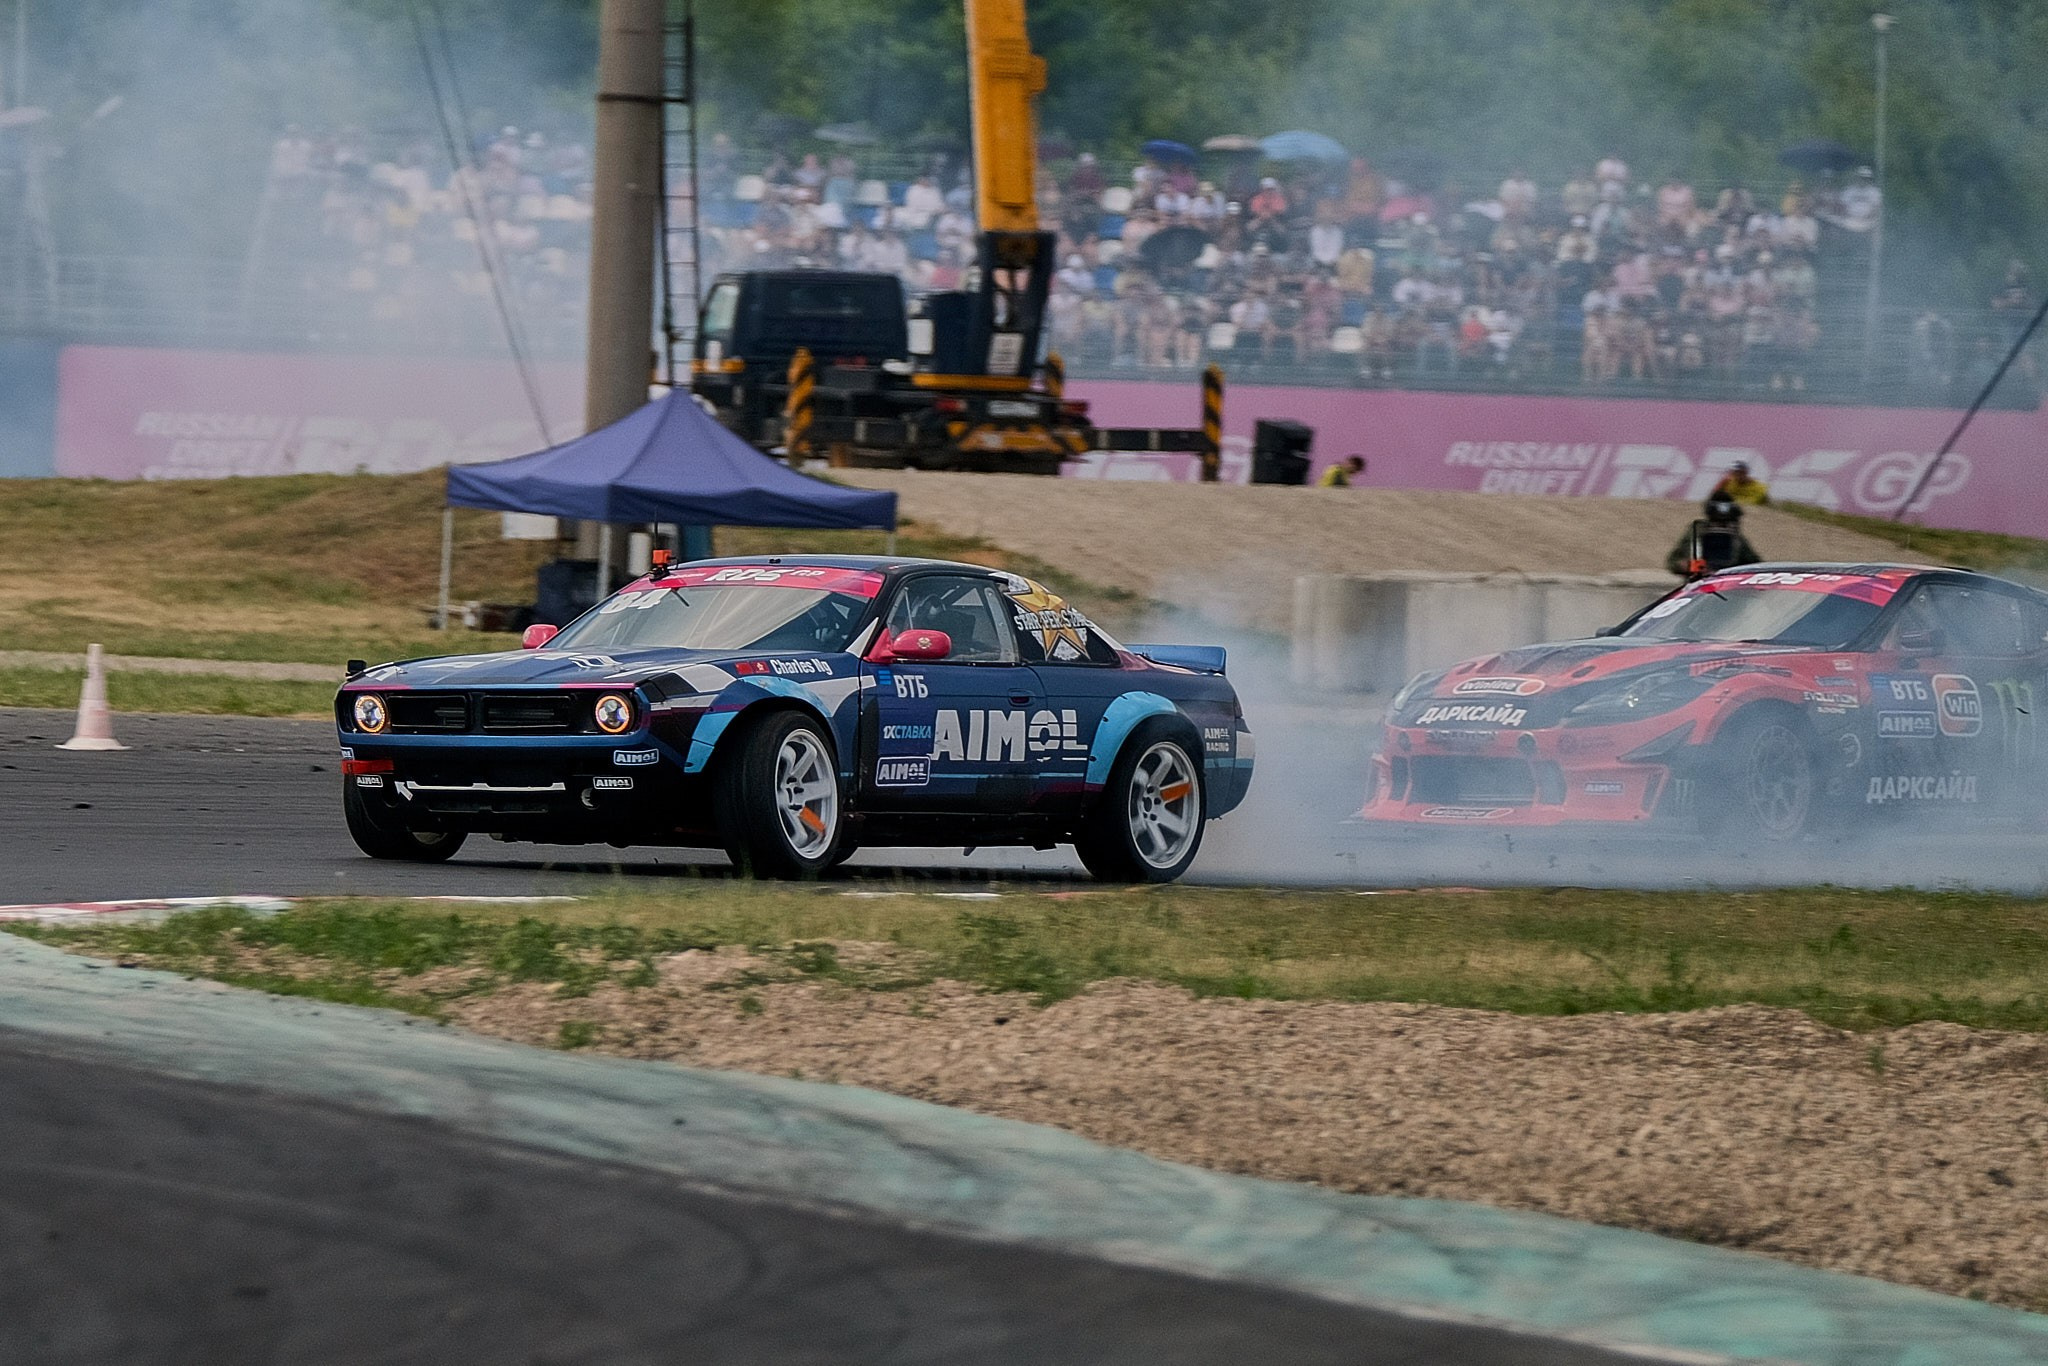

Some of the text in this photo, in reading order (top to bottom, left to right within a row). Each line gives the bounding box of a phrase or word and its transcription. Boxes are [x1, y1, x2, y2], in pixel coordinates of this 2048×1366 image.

[1446, 441, 1597, 466] RUSSIAN
[1480, 469, 1586, 495] DRIFT
[1854, 452, 1972, 513] GP
[704, 569, 793, 582] RDS
[1739, 573, 1816, 585] RDS
[600, 588, 672, 614] 84
[769, 659, 833, 675] Charles Ng
[894, 674, 929, 698] ВТБ
[1889, 680, 1928, 700] ВТБ
[1416, 703, 1528, 727] ДАРКСАЙД
[1947, 696, 1979, 715] Win
[1881, 716, 1931, 732] AIMOL
[927, 709, 1088, 762] AIMOL
[616, 753, 656, 763] AIMOL
[878, 763, 927, 780] AIMOL
[596, 779, 630, 787] AIMOL
[1866, 770, 1977, 803] ДАРКСАЙД
